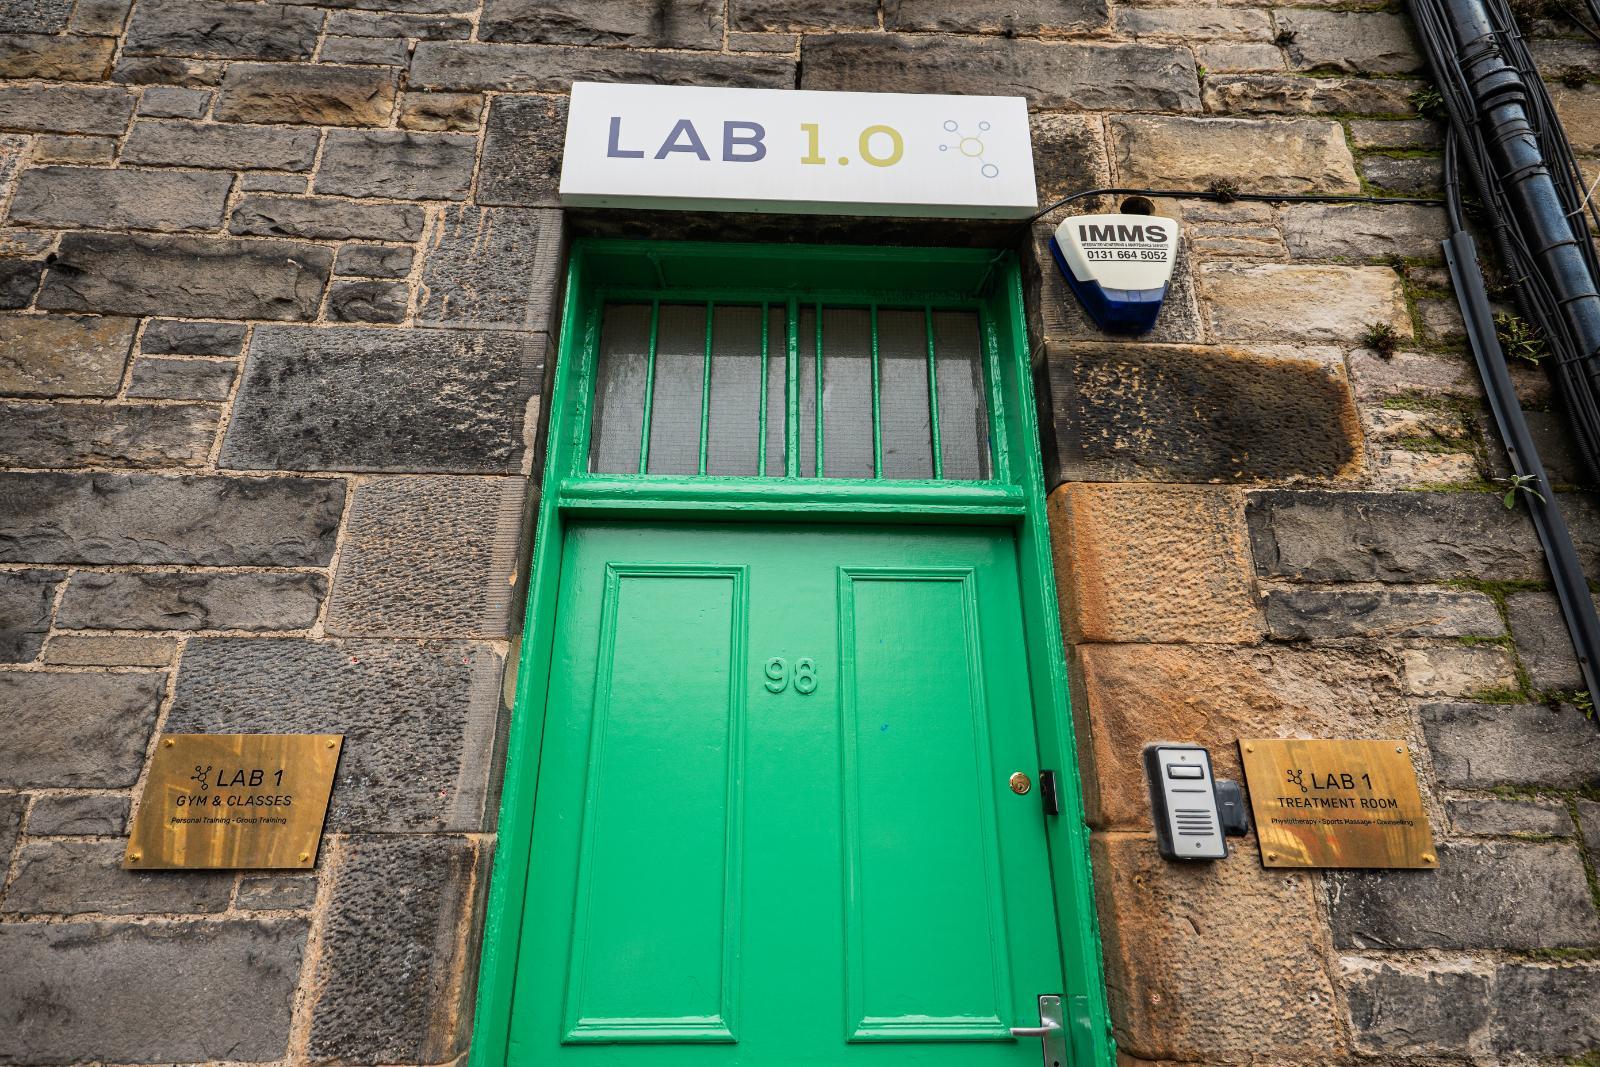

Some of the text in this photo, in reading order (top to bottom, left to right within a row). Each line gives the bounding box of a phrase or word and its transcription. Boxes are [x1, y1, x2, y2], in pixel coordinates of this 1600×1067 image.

[607, 117, 904, 167] LAB 1.0
[1079, 225, 1167, 242] IMMS
[1088, 251, 1167, 260] 0131 664 5052
[765, 657, 817, 695] 98
[217, 769, 283, 787] LAB 1
[1311, 773, 1373, 790] LAB 1
[176, 795, 292, 807] GYM & CLASSES
[1278, 797, 1398, 809] TREATMENT ROOM
[171, 816, 201, 824] Personal
[203, 816, 230, 825] Training
[236, 817, 257, 825] Group
[259, 817, 287, 825] Training
[1271, 817, 1317, 826] Physiotherapy
[1322, 818, 1344, 826] Sports
[1344, 818, 1372, 826] Massage
